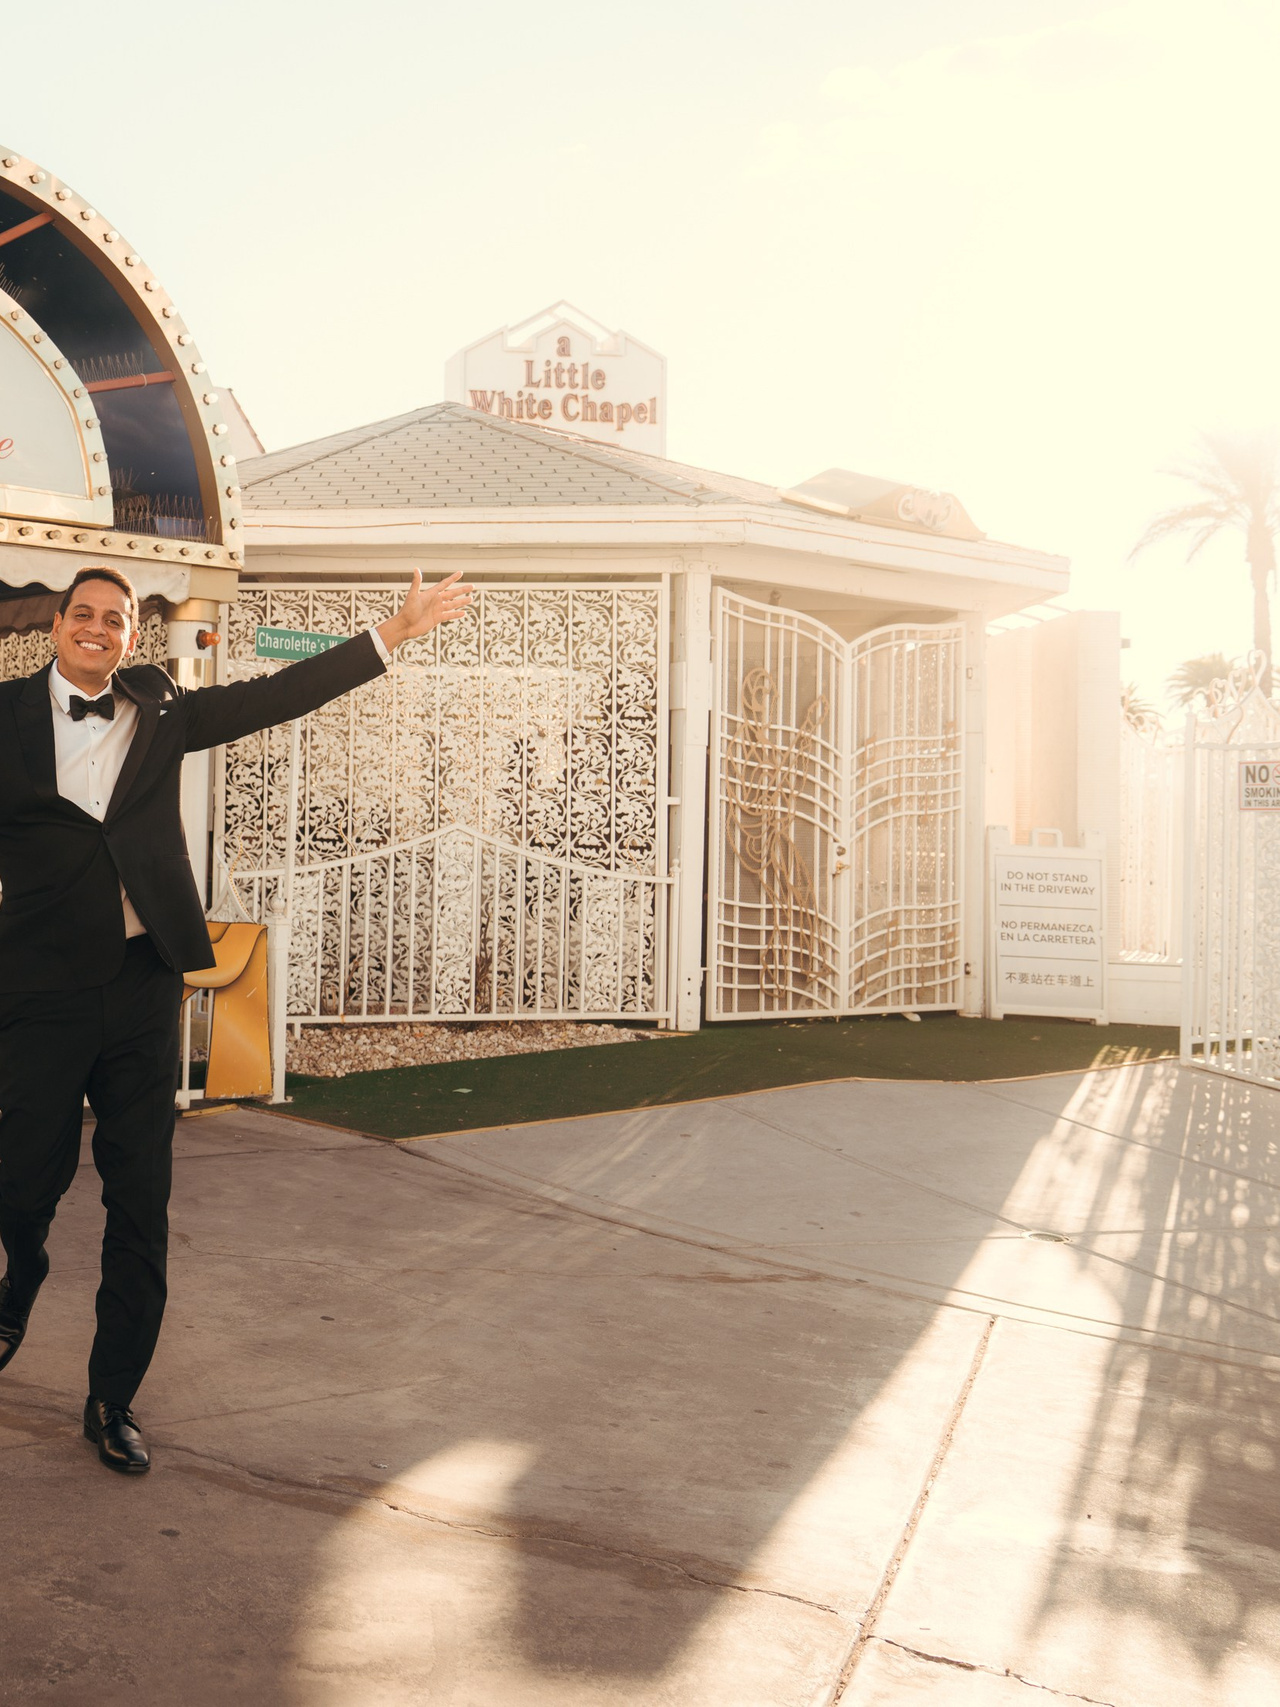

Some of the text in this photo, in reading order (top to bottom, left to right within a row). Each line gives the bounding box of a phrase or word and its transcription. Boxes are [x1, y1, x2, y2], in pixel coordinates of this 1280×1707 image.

[556, 336, 571, 357] a
[523, 359, 606, 390] Little
[469, 390, 657, 431] White Chapel
[258, 632, 326, 653] Charolette's
[1245, 765, 1269, 783] NO
[1007, 871, 1088, 883] DO NOT STAND
[1001, 883, 1095, 895] IN THE DRIVEWAY
[1001, 921, 1094, 933] NO PERMANEZCA
[1001, 932, 1096, 945] EN LA CARRETERA
[1005, 972, 1094, 987] 不要站在车道上
